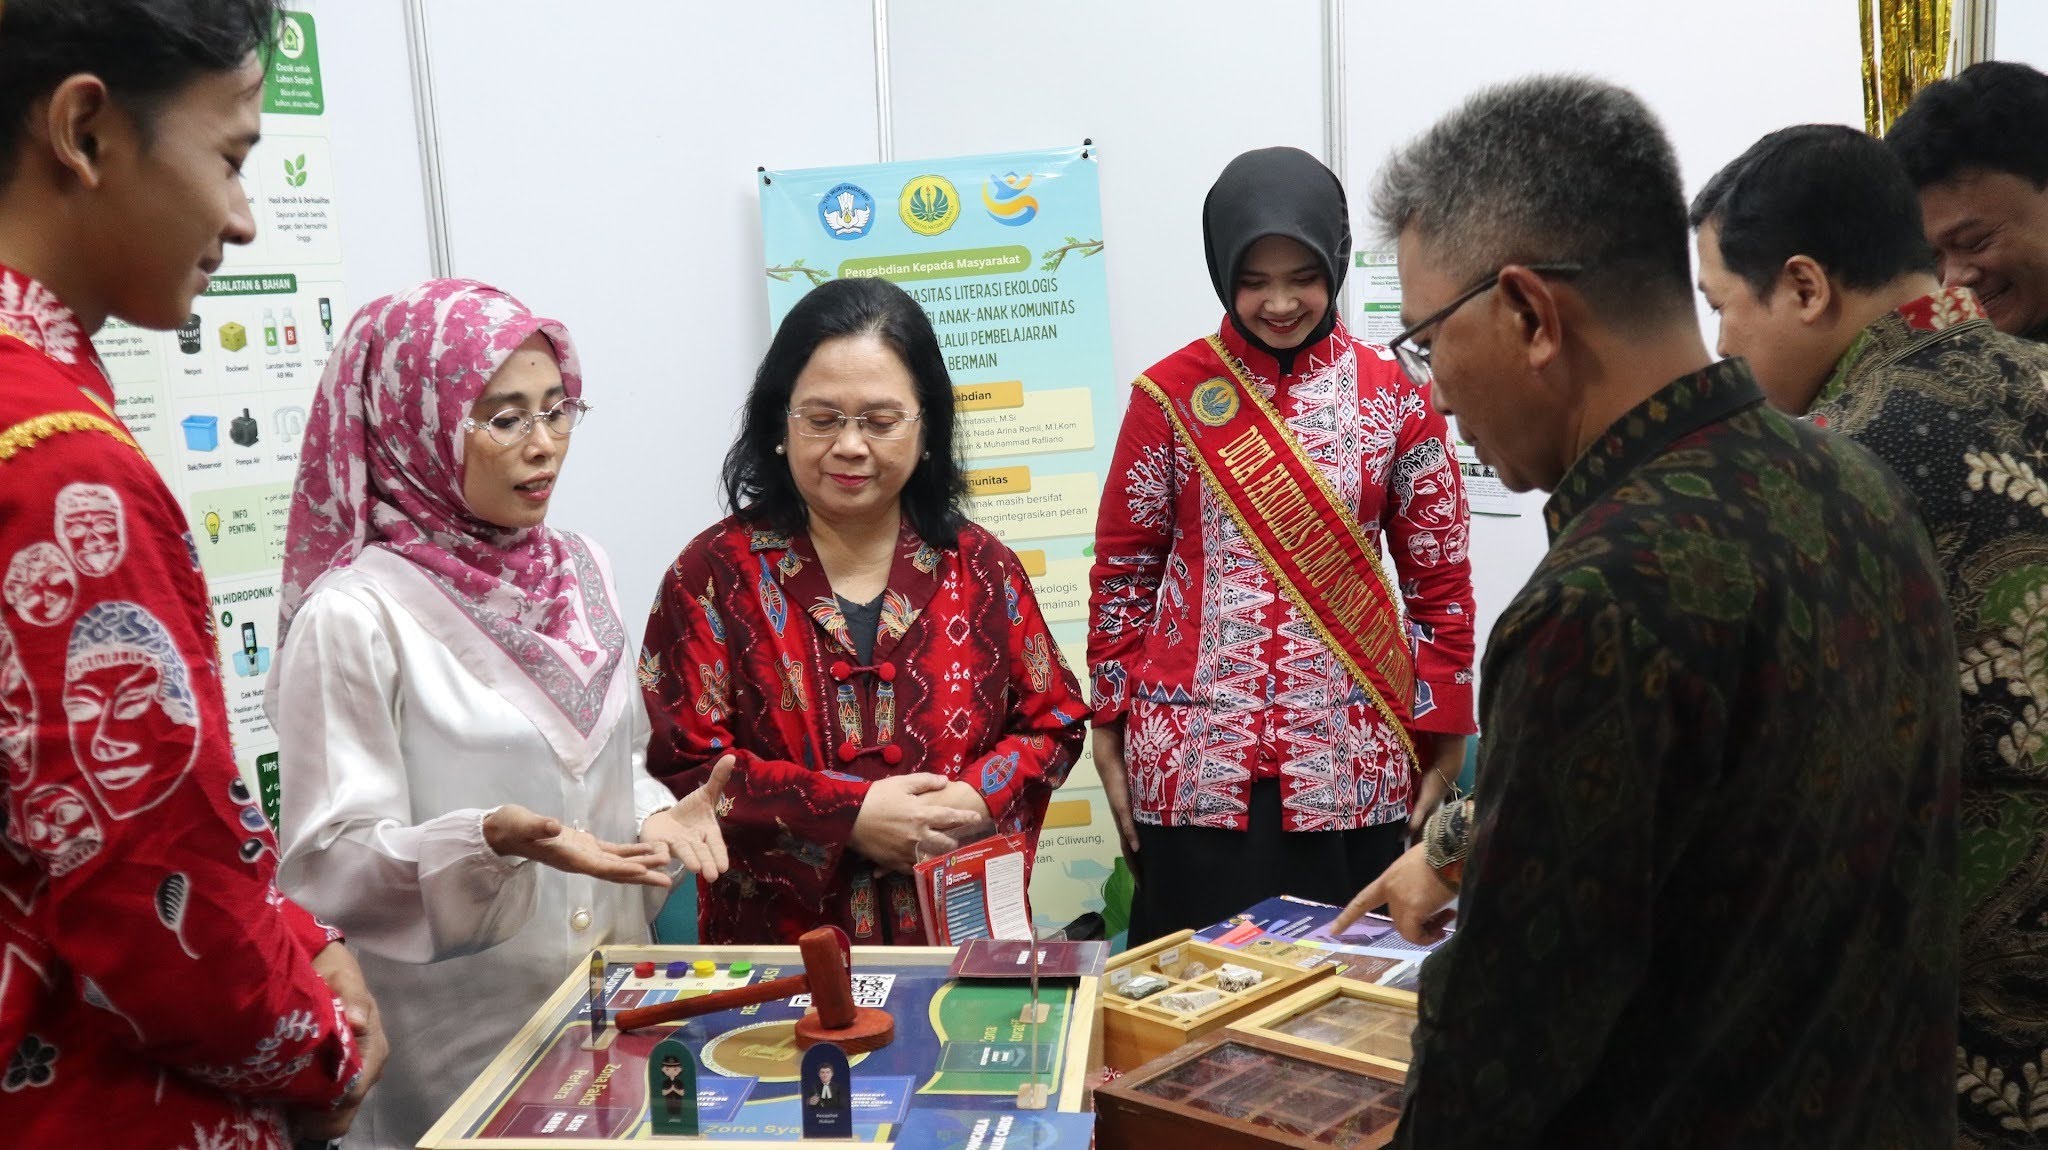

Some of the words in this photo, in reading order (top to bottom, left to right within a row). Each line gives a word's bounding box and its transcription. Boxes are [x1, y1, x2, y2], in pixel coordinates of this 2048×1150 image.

[845, 266, 910, 279] Pengabdian
[912, 260, 954, 274] Kepada
[956, 254, 1021, 269] Masyarakat
[254, 280, 262, 291] &
[262, 279, 291, 290] BAHAN
[954, 282, 1002, 301] LITERASI
[1005, 277, 1058, 297] EKOLOGIS
[938, 301, 1008, 326] ANAK-ANAK
[1011, 299, 1075, 319] KOMUNITAS
[937, 329, 969, 349] LALUI
[971, 324, 1058, 346] PEMBELAJARAN
[948, 352, 998, 371] BERMAIN
[955, 390, 992, 402] abdian
[999, 414, 1017, 423] M.Si
[973, 429, 995, 437] Nada
[996, 427, 1018, 435] Arina
[1045, 422, 1077, 431] M.I.Kom
[983, 438, 1030, 449] Muhammad
[1217, 425, 1276, 486] DUTA
[967, 475, 1008, 487] munitas
[996, 496, 1024, 506] masih
[1026, 492, 1062, 503] bersifat
[1243, 463, 1327, 551] FAKULTAS
[232, 509, 248, 519] INFO
[972, 509, 1058, 524] mengintegrasikan
[1060, 507, 1088, 517] peran
[228, 523, 257, 535] PENTING
[1291, 530, 1351, 588] ILMU
[222, 586, 274, 605] HIDROPONIK
[1034, 583, 1078, 595] ekologis
[1039, 599, 1080, 611] rmainan
[1320, 565, 1378, 635] SOSIAL
[262, 761, 277, 772] TIPS
[1038, 838, 1054, 849] gai
[1056, 834, 1105, 847] Ciliwung,
[1033, 854, 1055, 864] tan.
[945, 874, 953, 886] 15
[594, 1063, 622, 1084] Zona
[553, 1069, 589, 1100] Perkara
[578, 1083, 608, 1106] Fakta
[541, 1112, 568, 1134] CARDS
[565, 1114, 588, 1132] CASE
[703, 1123, 758, 1134] Zona
[763, 1124, 801, 1136] Sya
[965, 1118, 990, 1150] ANCASILA
